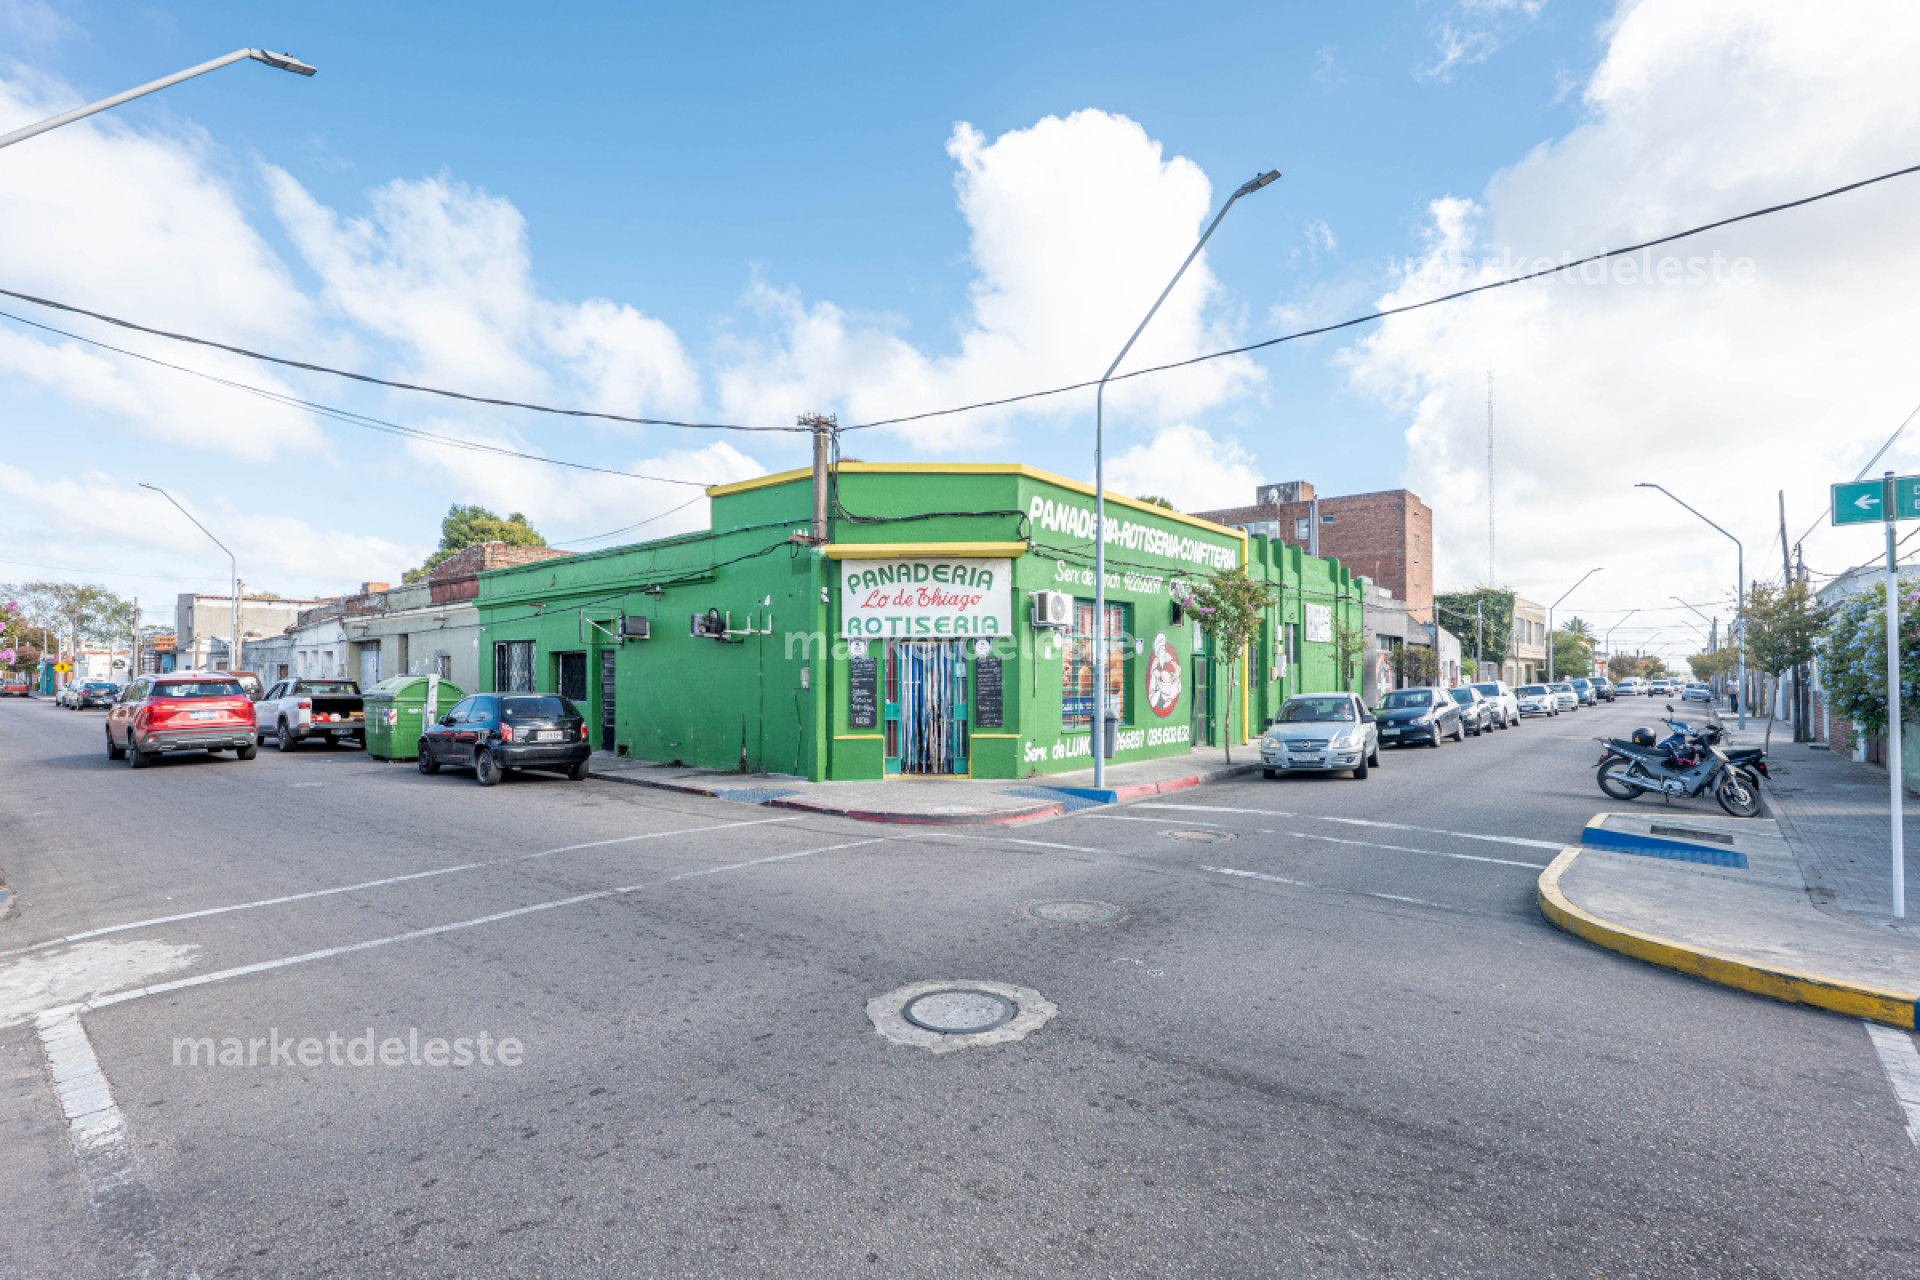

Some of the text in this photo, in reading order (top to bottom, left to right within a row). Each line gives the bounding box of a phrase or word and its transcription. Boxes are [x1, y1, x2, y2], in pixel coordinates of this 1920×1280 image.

[847, 563, 994, 595] PANADERIA
[861, 586, 983, 611] Lo de Thiago
[847, 615, 999, 636] ROTISERIA
[1052, 737, 1065, 760] de
